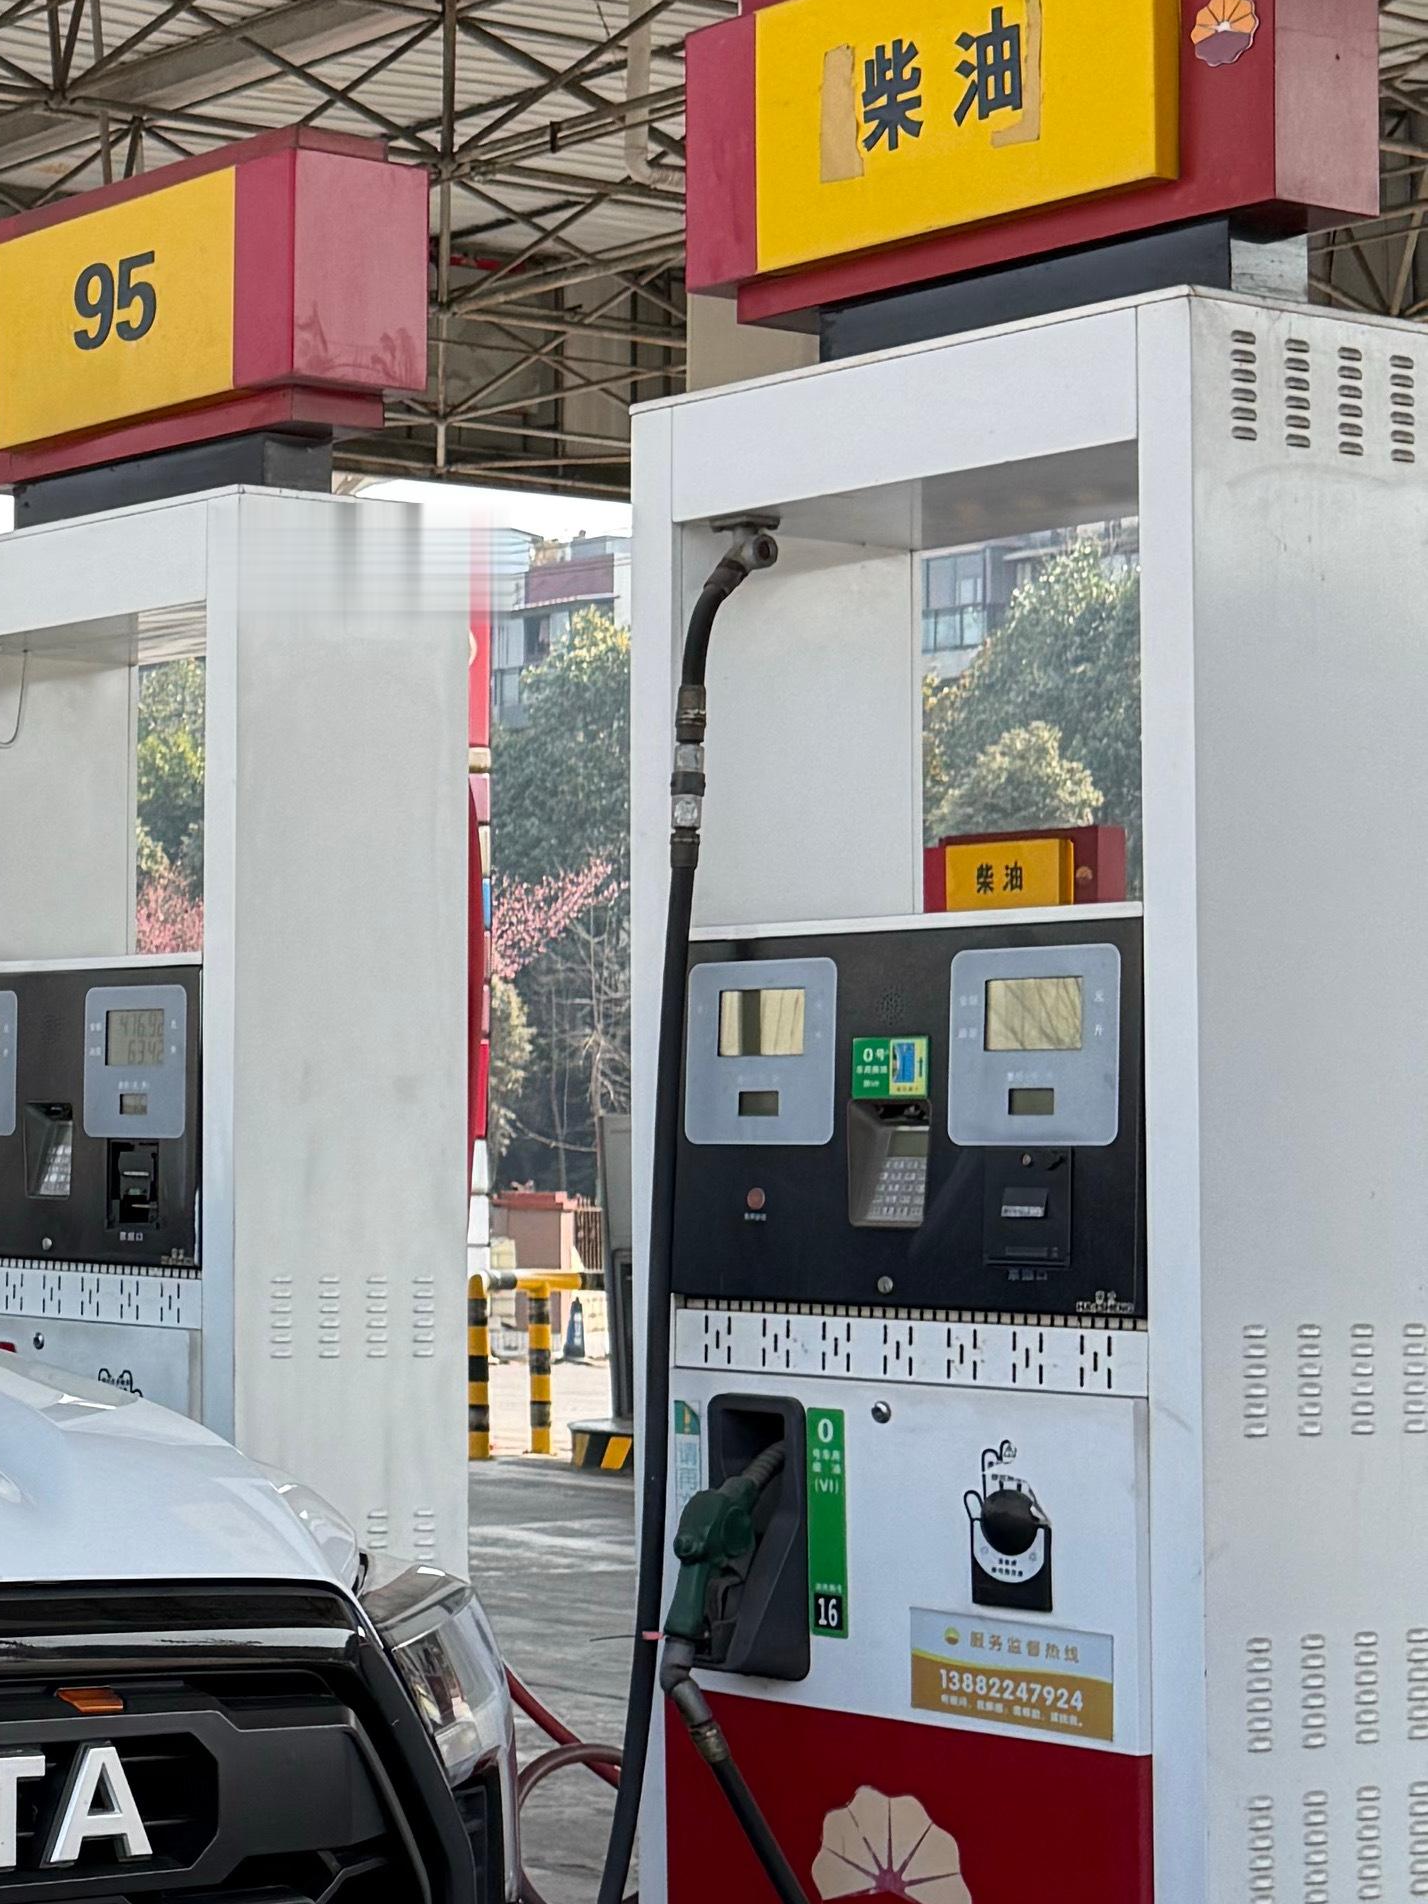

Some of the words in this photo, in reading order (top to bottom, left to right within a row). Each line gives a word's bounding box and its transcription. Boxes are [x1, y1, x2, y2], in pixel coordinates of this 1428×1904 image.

[861, 6, 1023, 153] 柴油
[73, 250, 157, 351] 95
[976, 860, 1023, 895] 柴油
[817, 1418, 834, 1443] 0
[818, 1597, 838, 1627] 16
[969, 1630, 1080, 1664] 服务监督热线
[939, 1668, 1084, 1712] 13882247924
